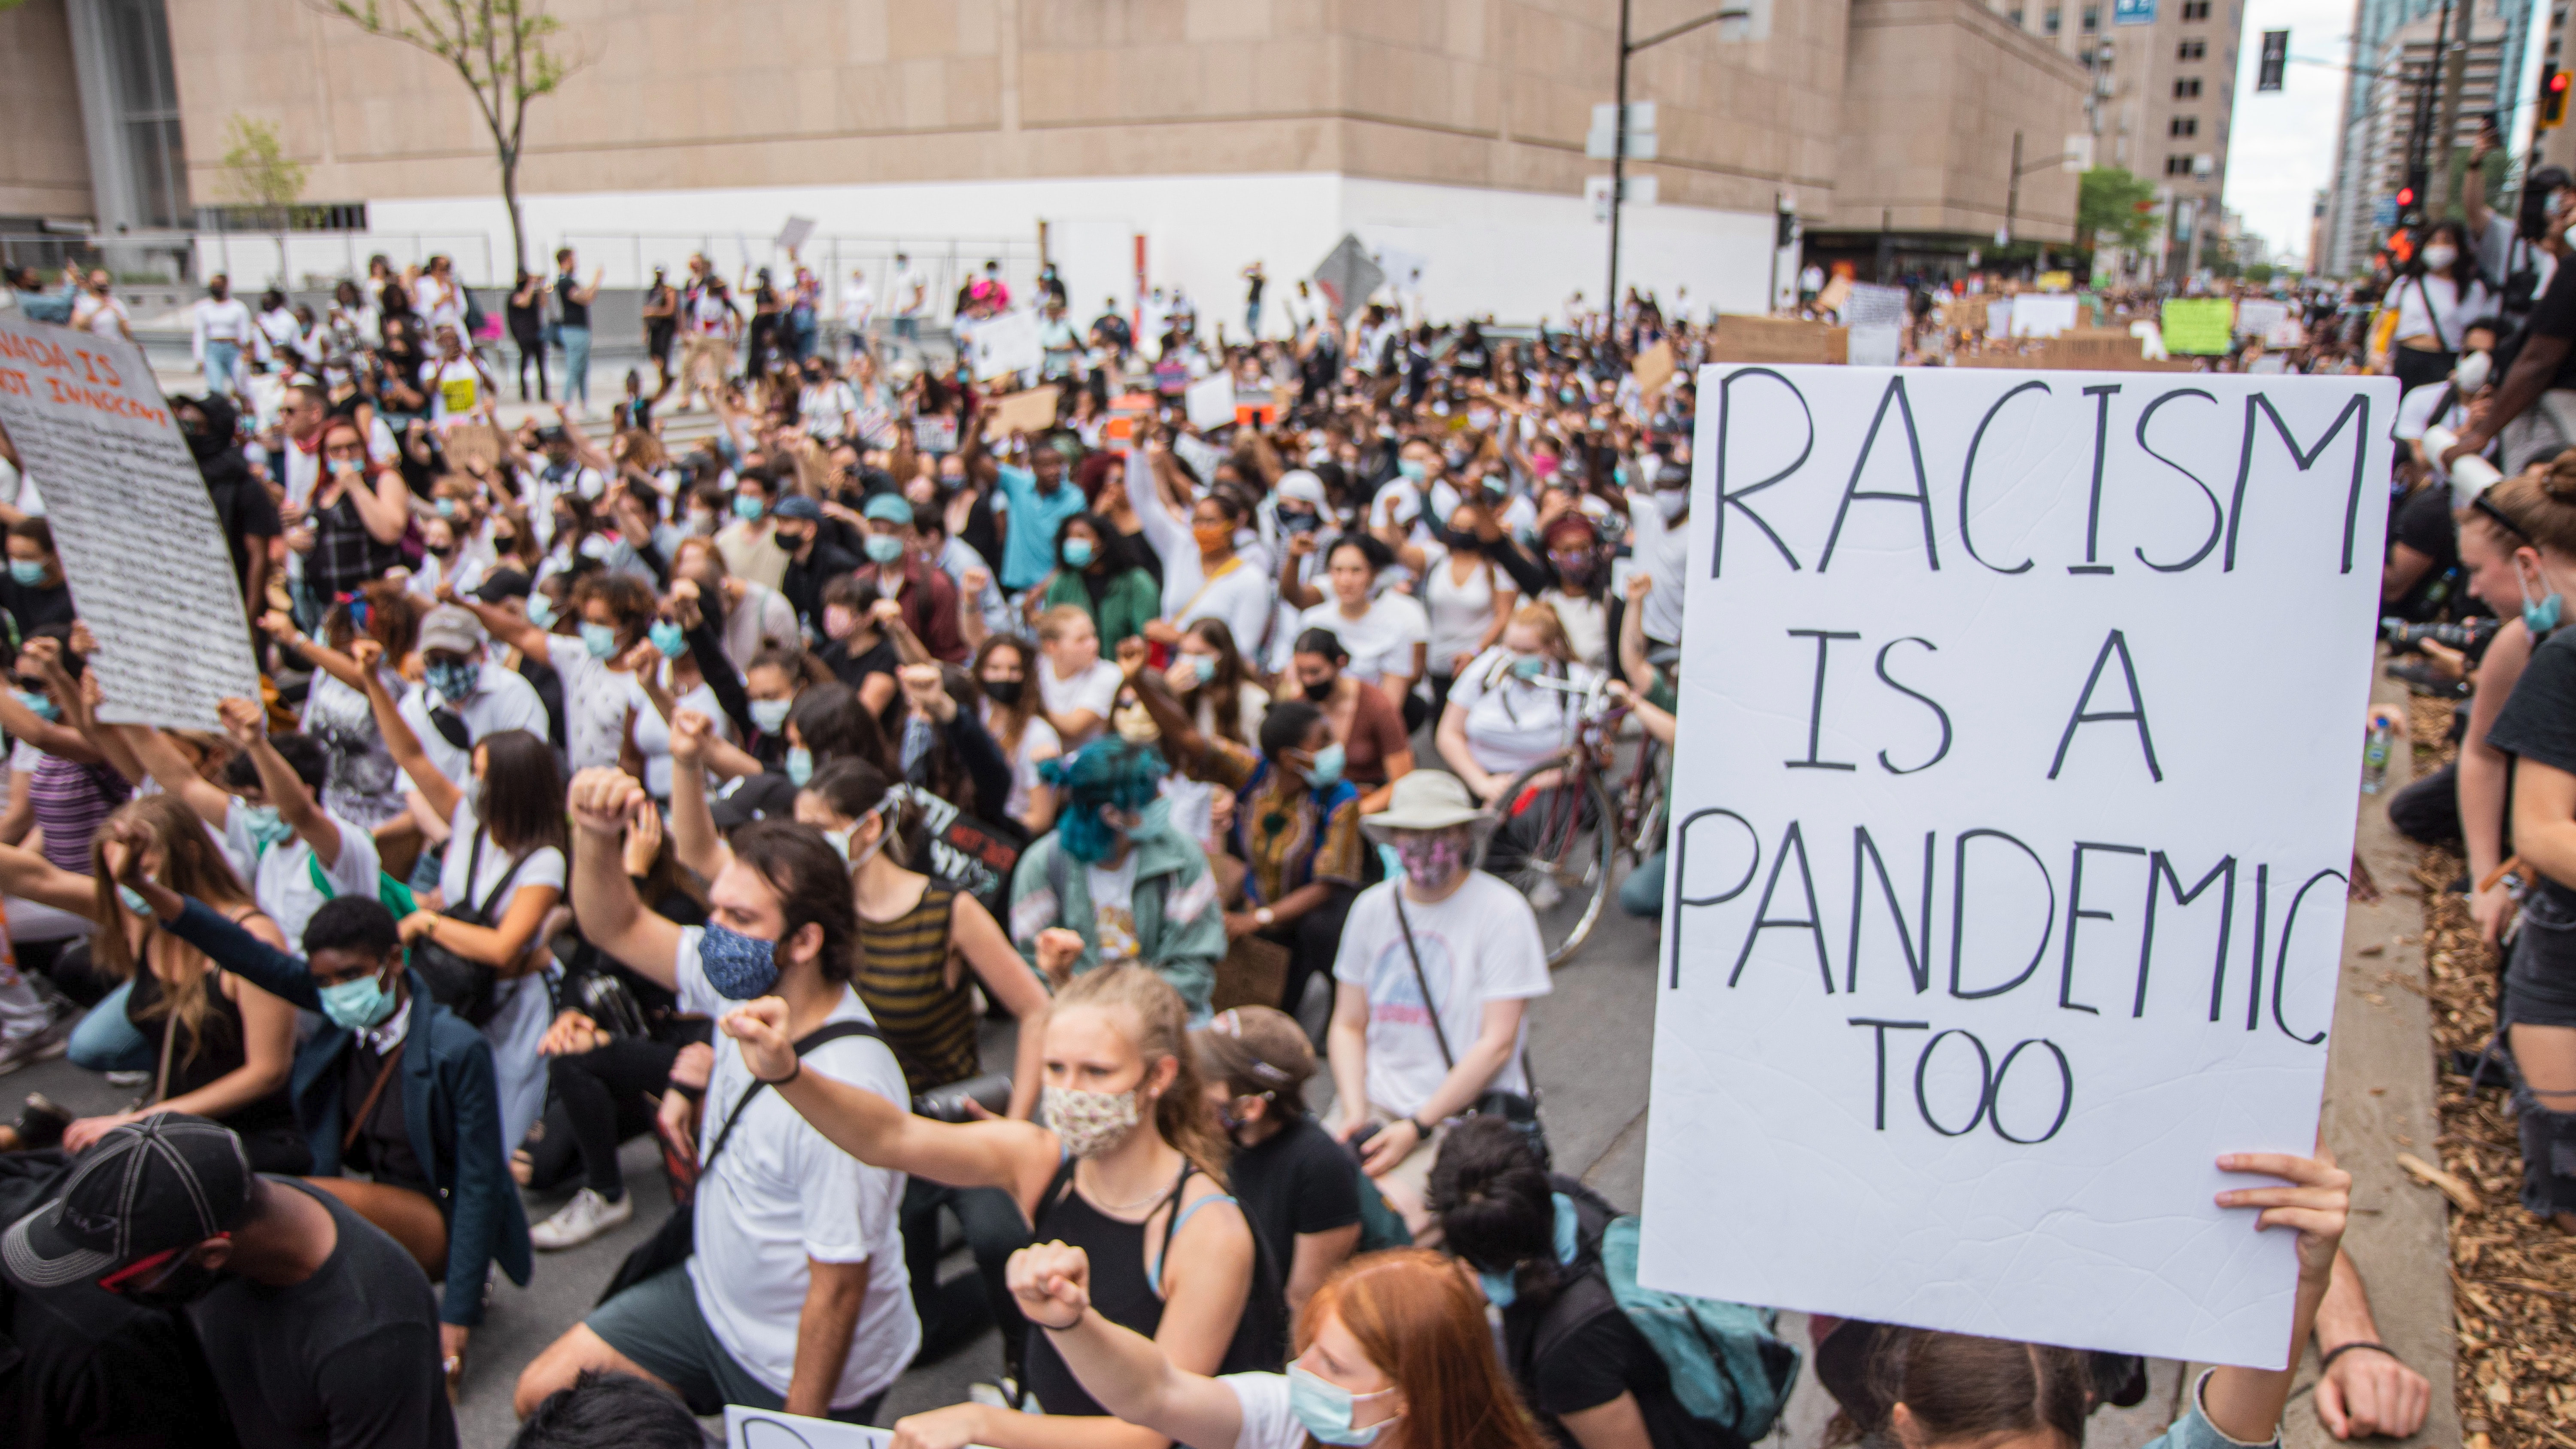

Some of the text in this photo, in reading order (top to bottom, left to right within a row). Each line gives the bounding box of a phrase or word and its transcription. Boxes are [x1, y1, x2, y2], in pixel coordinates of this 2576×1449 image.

[74, 349, 122, 387] IS
[1711, 367, 2370, 579] RACISM
[1785, 629, 2163, 783] IS A
[1669, 807, 2348, 1045] PANDEMIC
[1848, 1018, 2073, 1145] TOO
